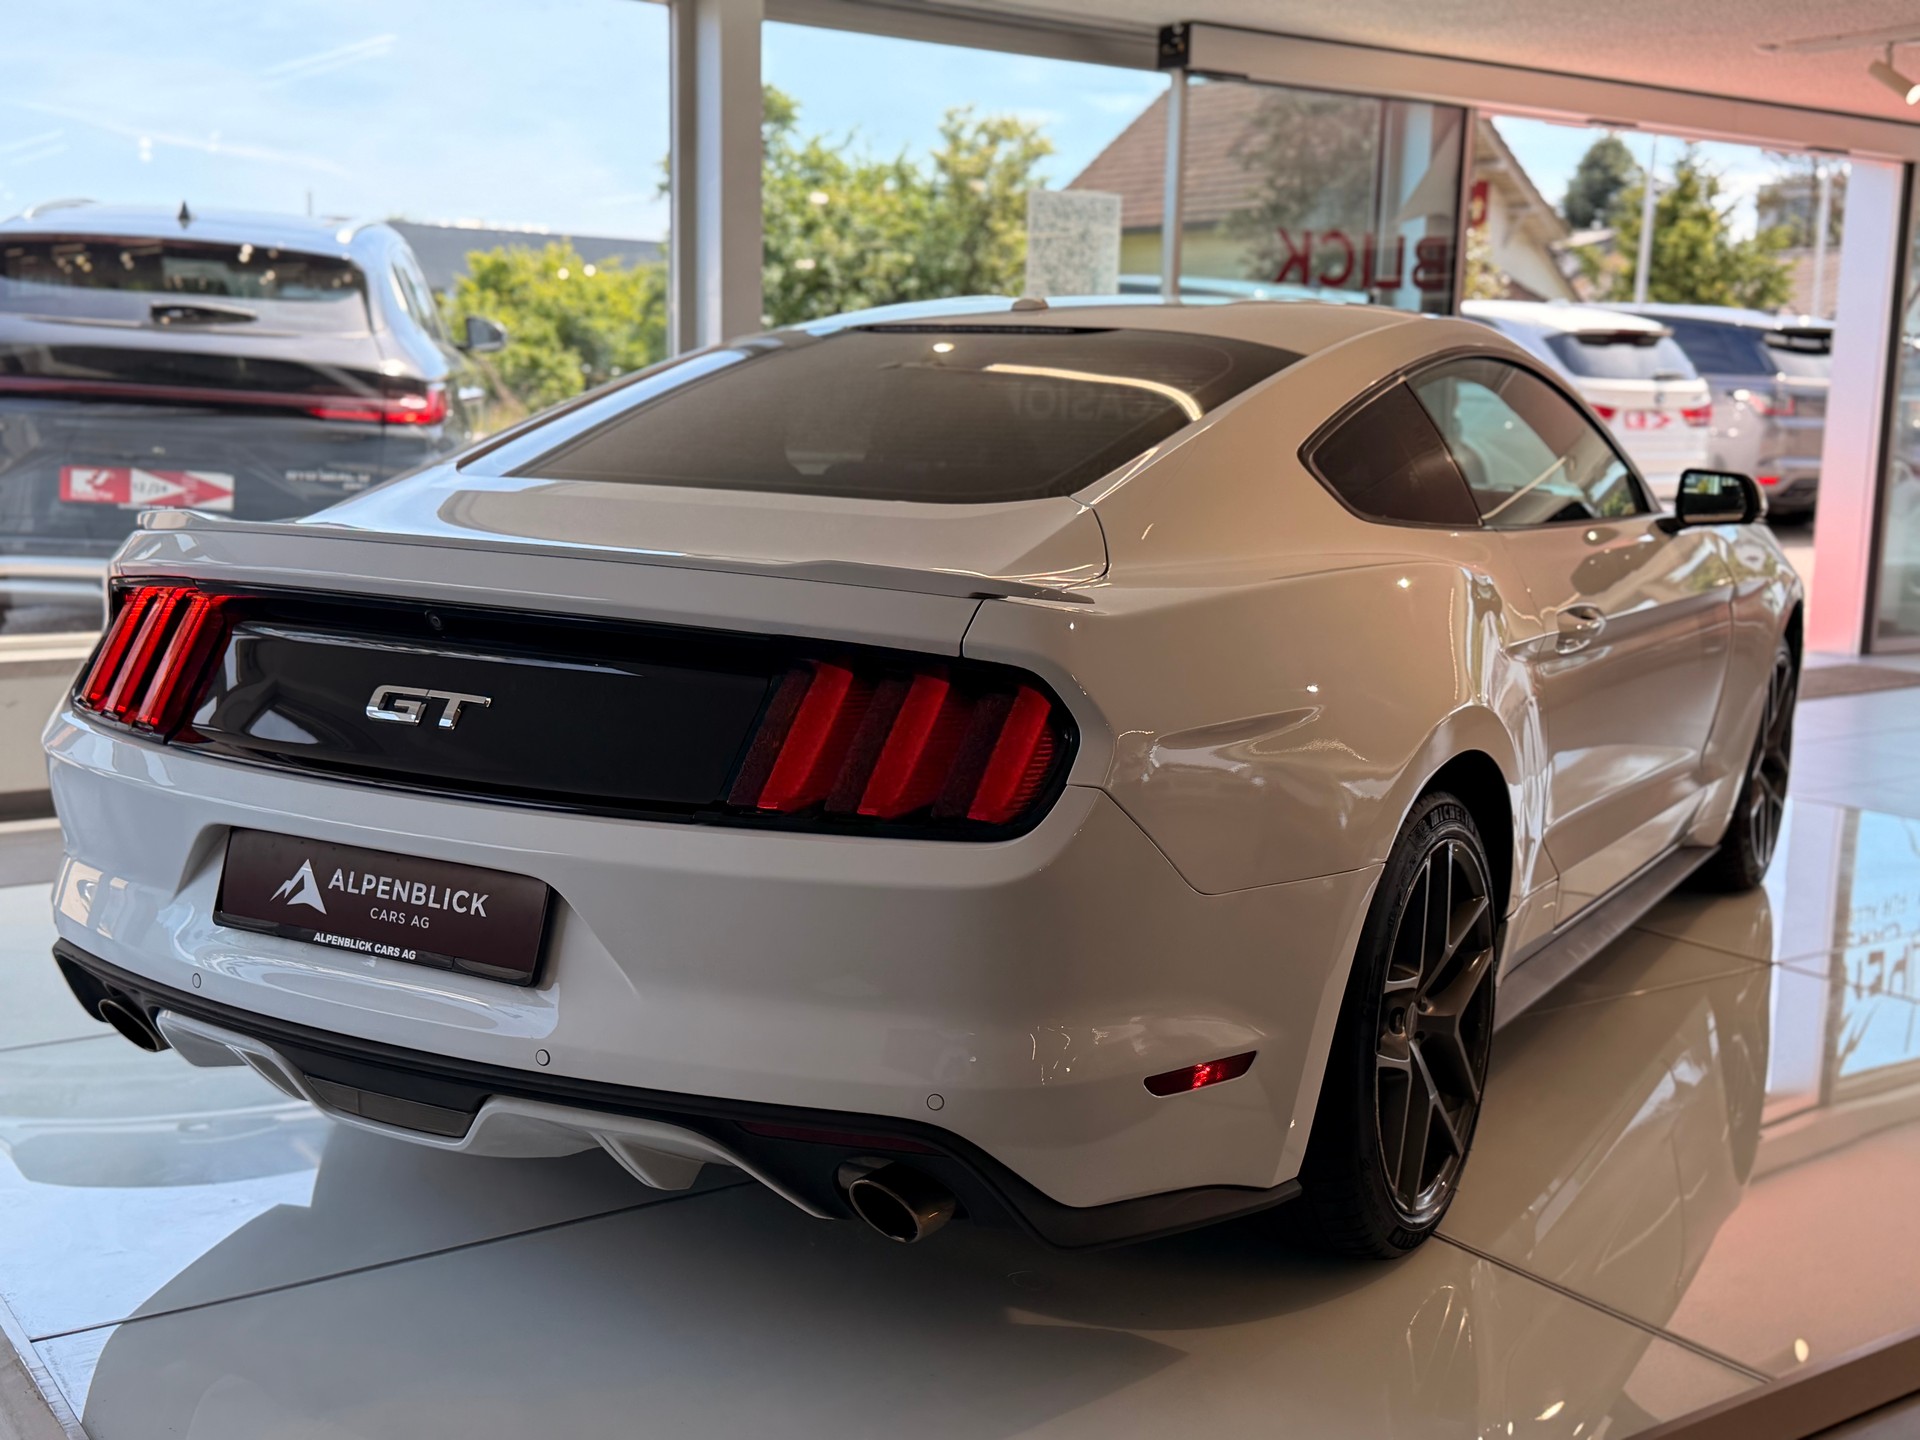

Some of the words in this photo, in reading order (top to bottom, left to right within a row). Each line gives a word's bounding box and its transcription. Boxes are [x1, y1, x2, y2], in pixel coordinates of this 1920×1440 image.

[366, 684, 492, 730] GT
[328, 868, 490, 917] ALPENBLICK
[370, 907, 406, 925] CARS
[411, 915, 430, 929] AG
[313, 932, 372, 952] ALPENBLICK
[374, 943, 400, 957] CARS
[401, 949, 416, 960] AG
